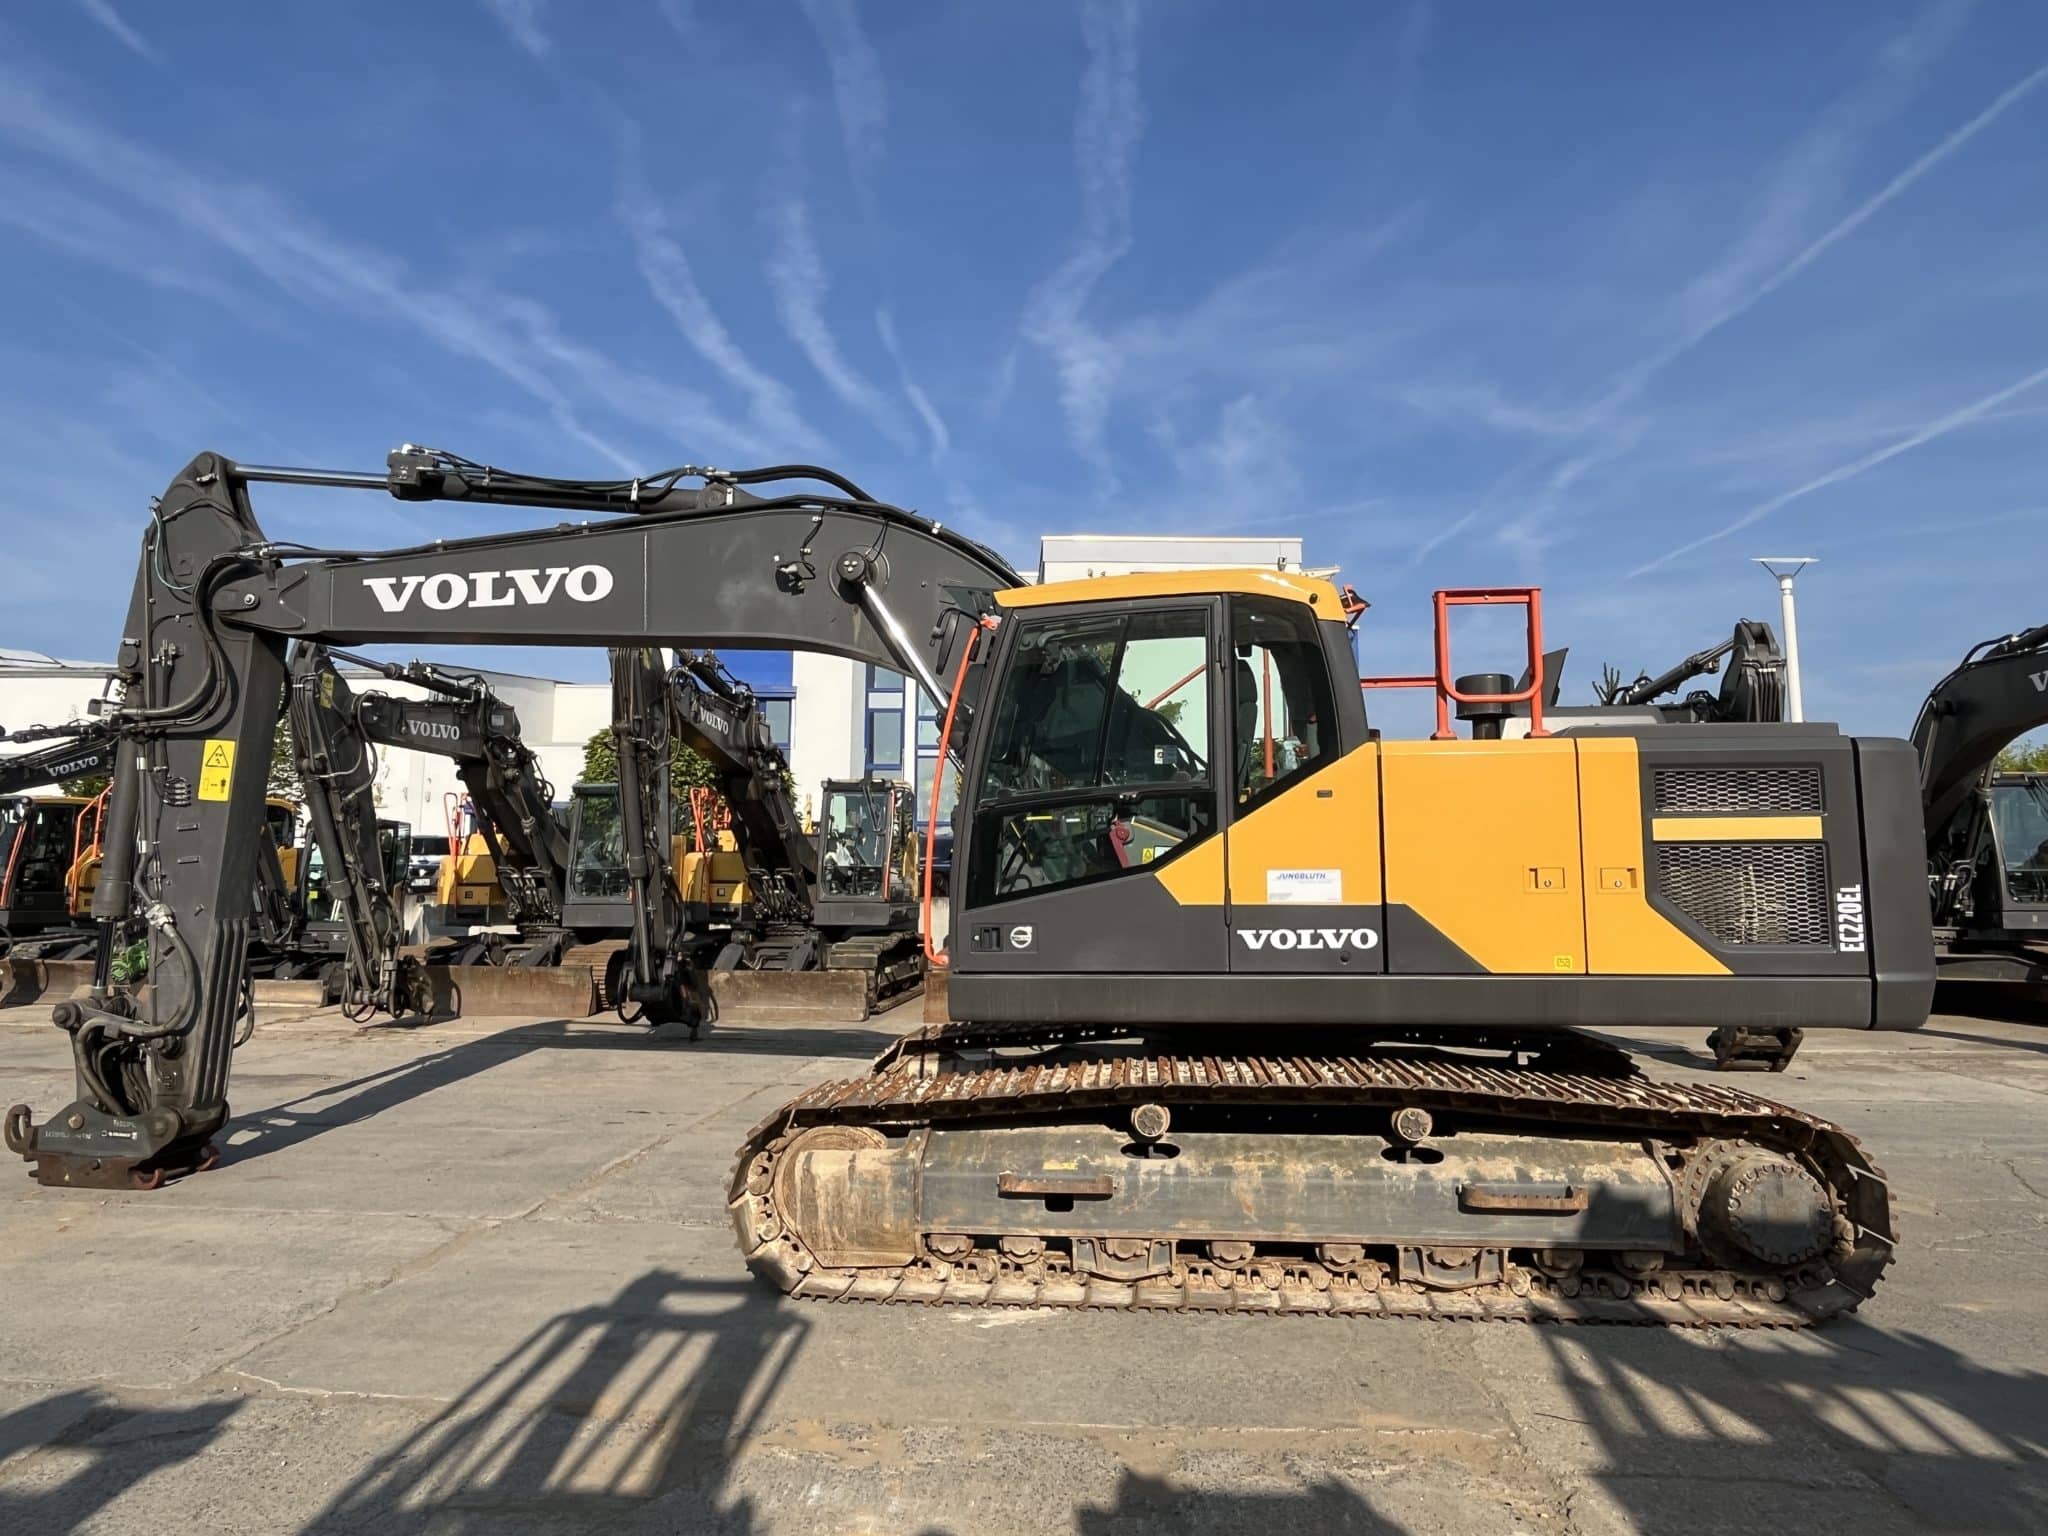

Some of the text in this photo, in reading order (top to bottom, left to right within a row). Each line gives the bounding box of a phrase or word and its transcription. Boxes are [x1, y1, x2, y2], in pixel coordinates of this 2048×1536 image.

[362, 564, 614, 612] VOLVO
[407, 719, 460, 740] VOLVO
[700, 706, 729, 735] VOLVO
[45, 756, 99, 777] VOLVO
[1837, 884, 1865, 952] EC220EL
[1236, 928, 1378, 950] VOLVO
